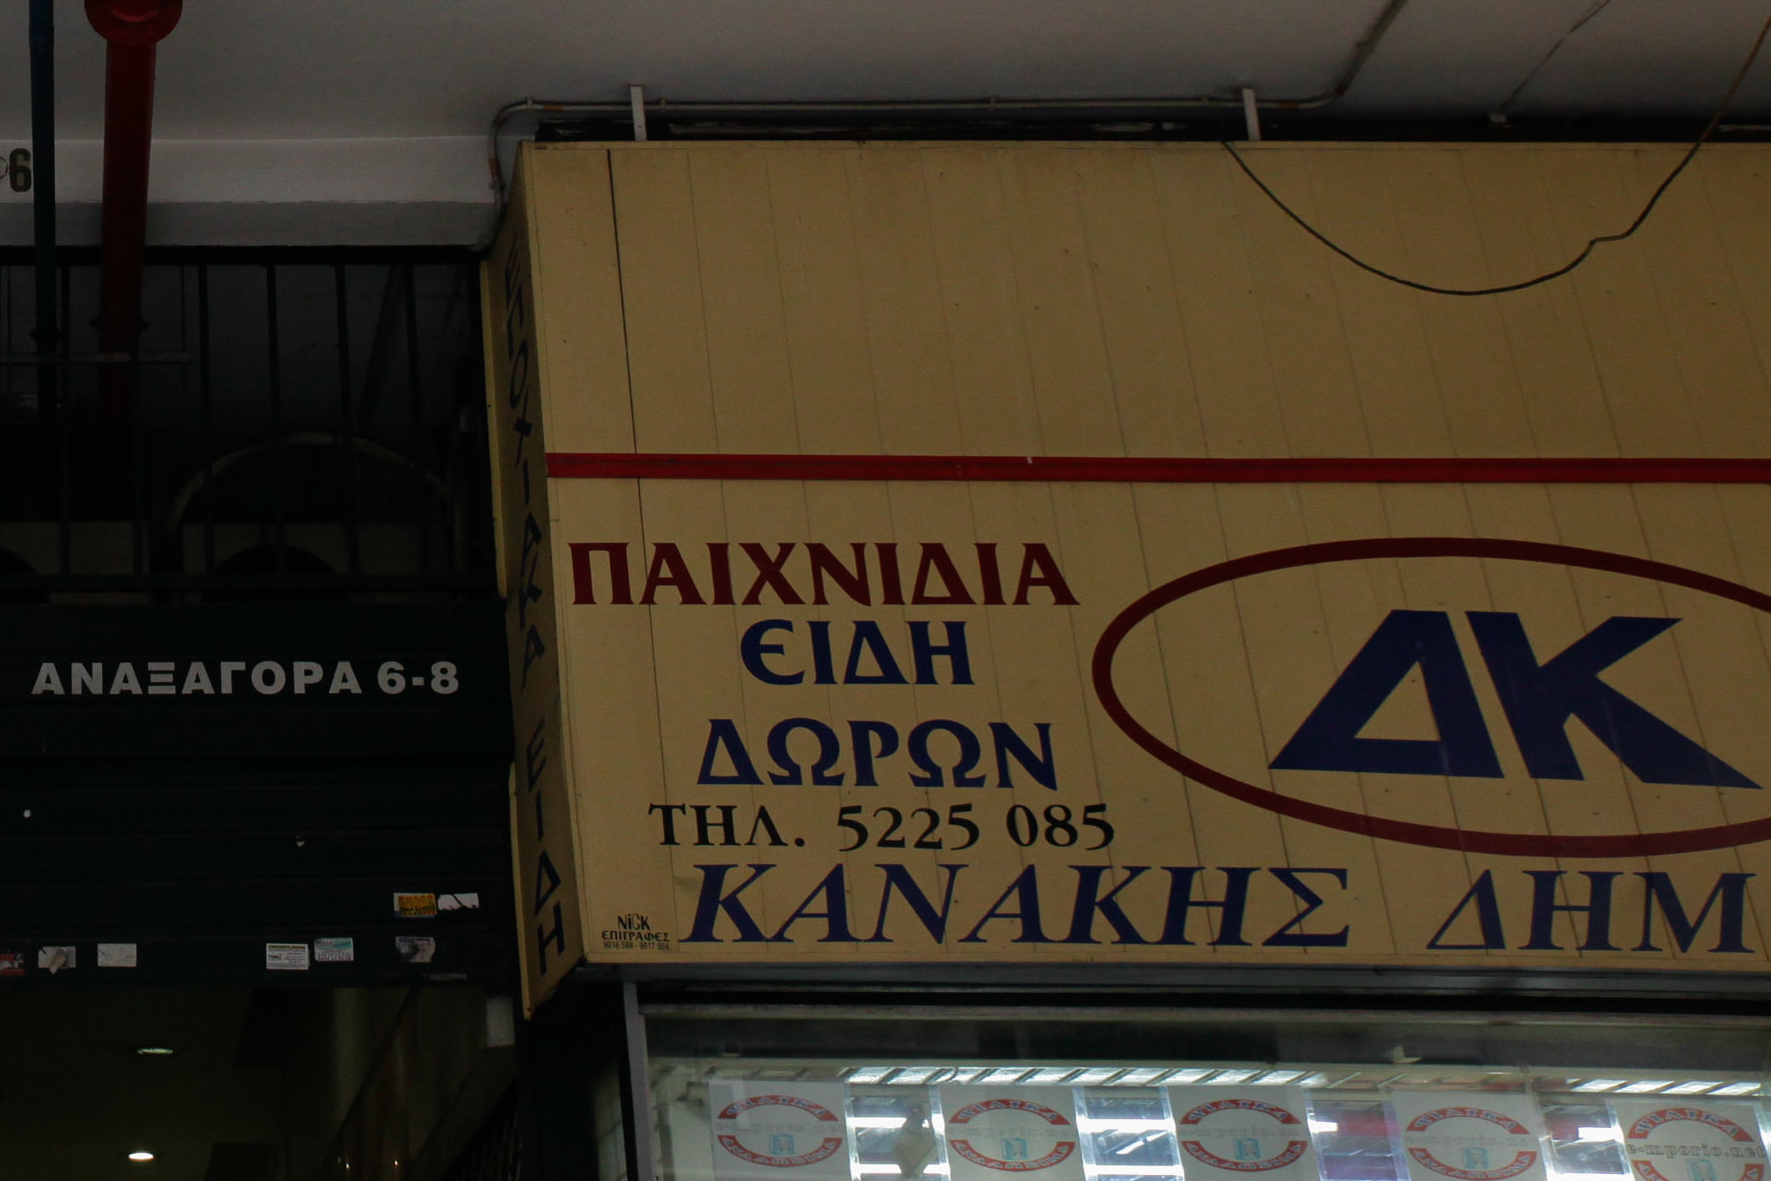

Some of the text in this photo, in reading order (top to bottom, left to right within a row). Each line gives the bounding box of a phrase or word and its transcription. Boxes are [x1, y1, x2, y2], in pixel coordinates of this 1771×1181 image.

[567, 542, 1081, 607] ΠΑΙΧΝΙΔΙΑ
[31, 661, 362, 695] ΑΝΑΞΑΓΟΡΑ
[377, 661, 459, 695] 6-8
[740, 619, 976, 685] ΕΙΔΗ
[697, 717, 1058, 791] ΔΩΡΩΝ
[648, 802, 1116, 852] ΤΗΛ. 5225 085
[678, 863, 1350, 950] ΚΑΝΑΚΗΣ
